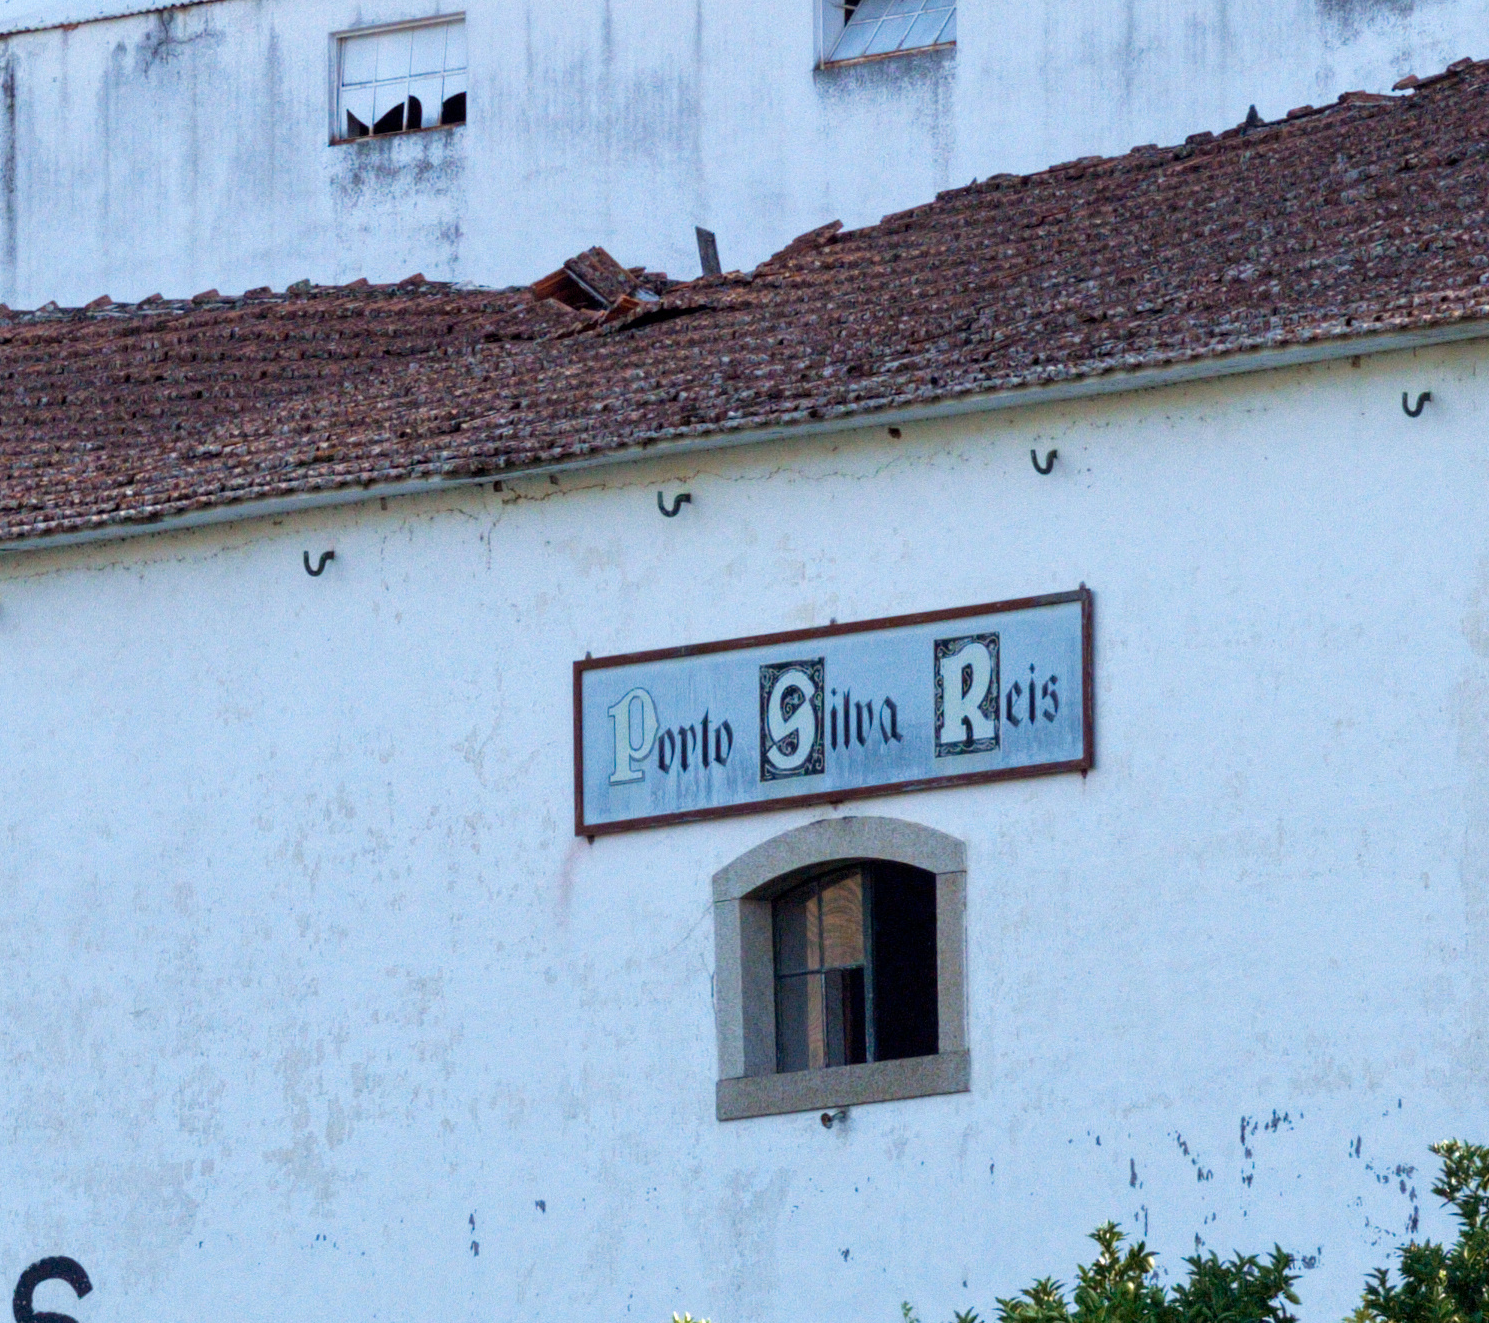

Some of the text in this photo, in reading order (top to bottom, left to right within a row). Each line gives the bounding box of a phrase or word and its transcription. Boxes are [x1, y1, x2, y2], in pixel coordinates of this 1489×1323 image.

[608, 632, 1060, 787] Porto Silva Reis
